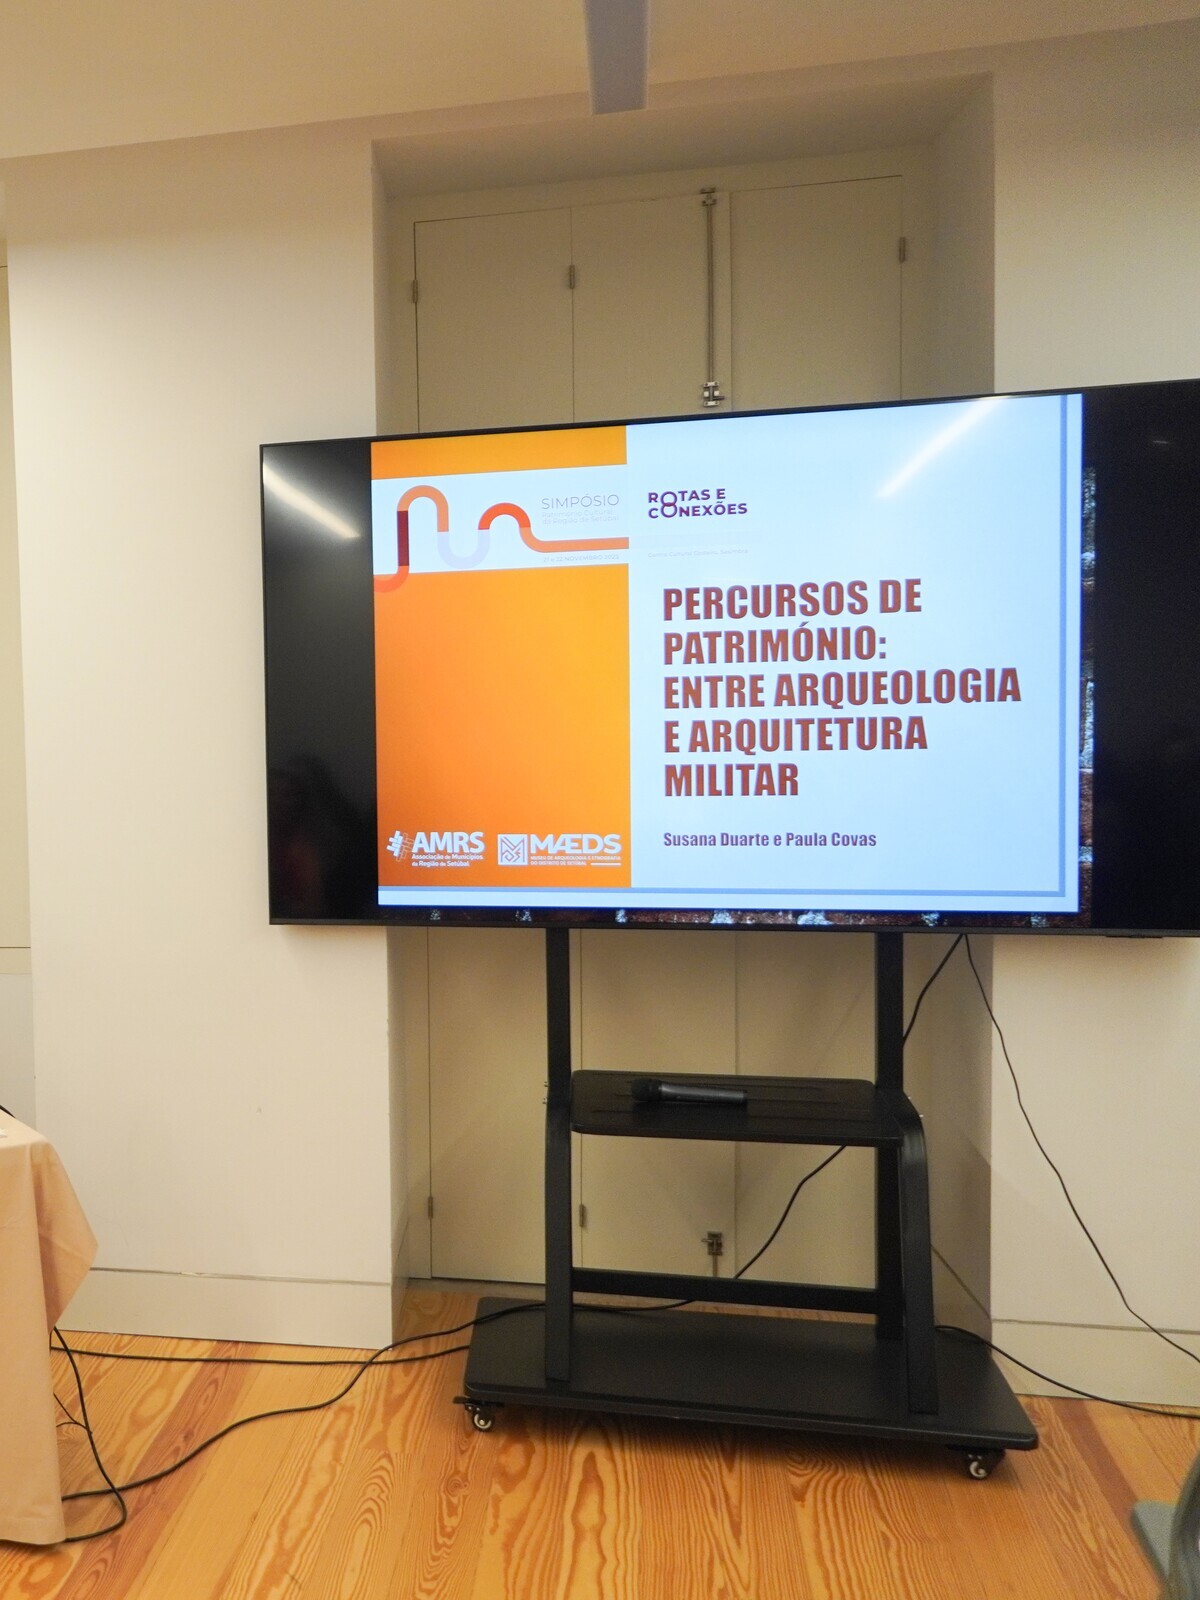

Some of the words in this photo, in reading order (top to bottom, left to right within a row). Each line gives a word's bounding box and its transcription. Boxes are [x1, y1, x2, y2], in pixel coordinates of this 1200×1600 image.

[541, 493, 620, 510] SIMPÓSIO
[648, 489, 711, 507] ROTAS
[716, 488, 726, 500] E
[648, 501, 748, 519] CONEXÕES
[663, 580, 869, 621] PERCURSOS
[879, 578, 922, 613] DE
[663, 621, 887, 665] PATRIMÓNIO:
[664, 674, 765, 709] ENTRE
[773, 667, 1022, 710] ARQUEOLOGIA
[664, 720, 680, 753] E
[688, 715, 928, 756] ARQUITETURA
[664, 763, 799, 797] MILITAR
[411, 831, 486, 854] AMRS
[663, 832, 717, 847] Susana
[720, 832, 770, 847] Duarte
[773, 834, 782, 846] e
[785, 832, 827, 847] Paula
[831, 832, 877, 846] Covas
